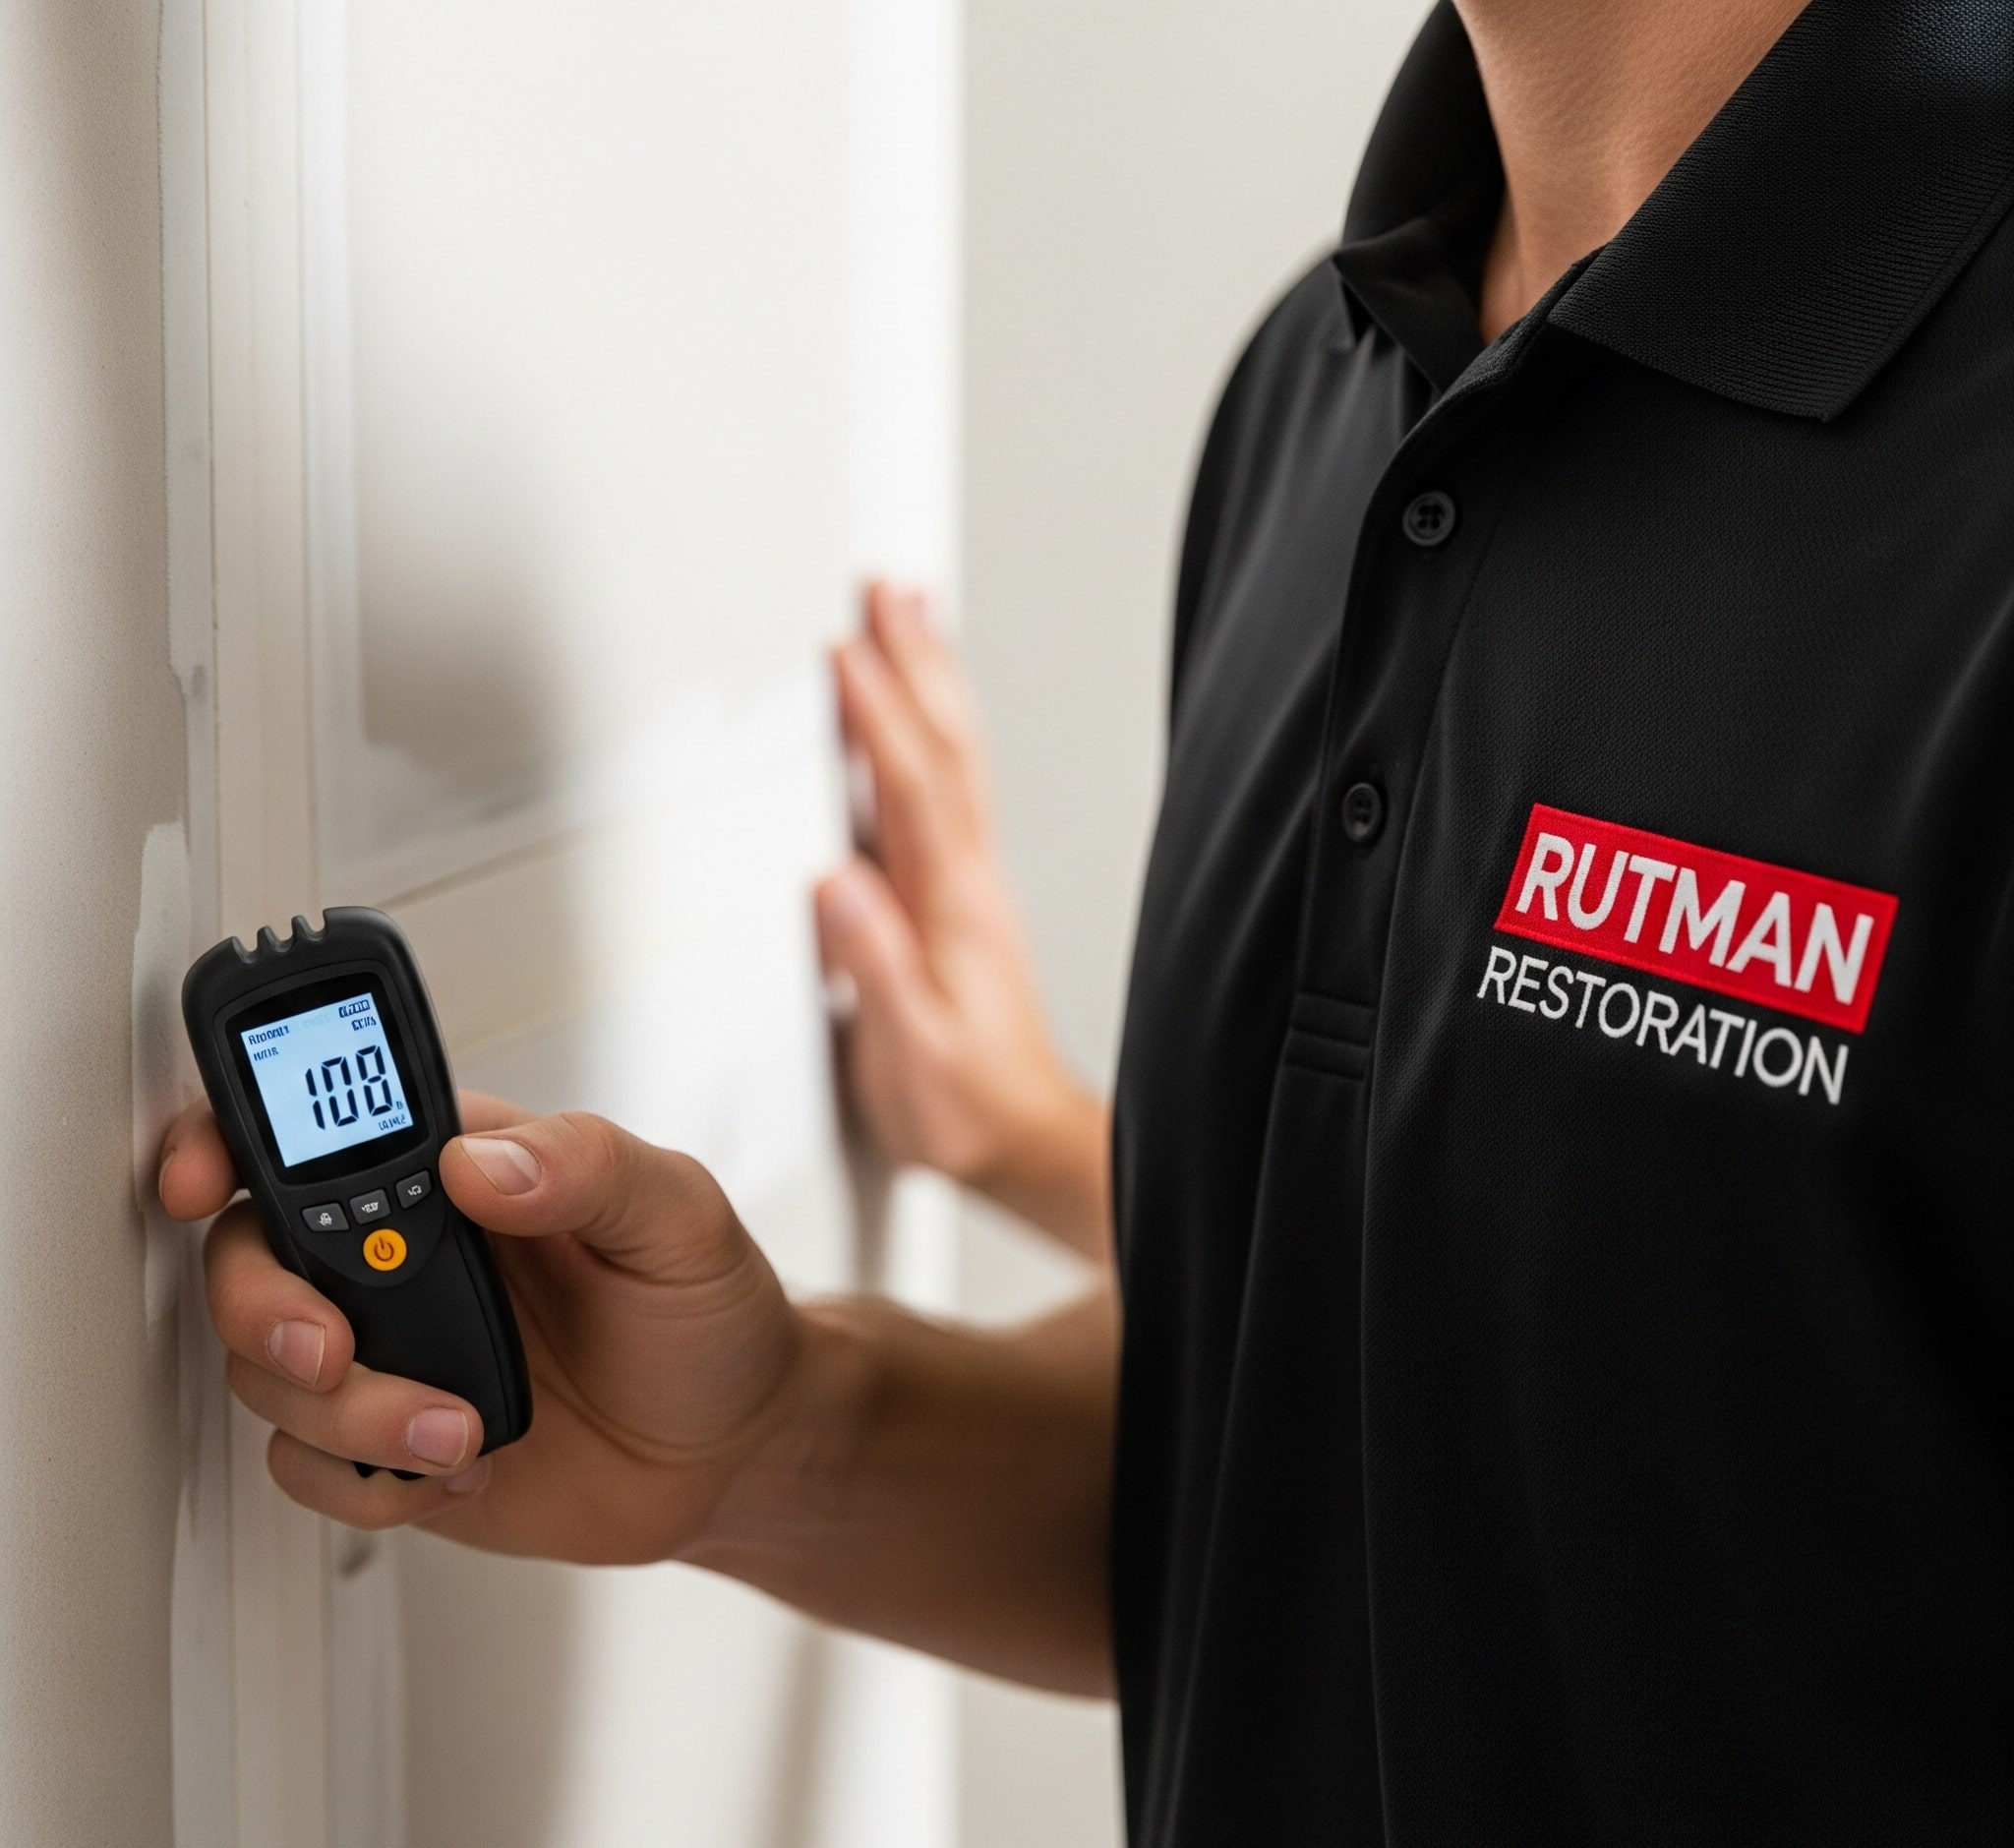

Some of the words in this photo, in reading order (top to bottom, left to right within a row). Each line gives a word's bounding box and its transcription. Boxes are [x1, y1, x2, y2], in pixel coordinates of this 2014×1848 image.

[1515, 832, 1873, 1005] RUTMAN
[305, 1044, 392, 1130] 108
[1477, 945, 1849, 1105] RESTORATION
